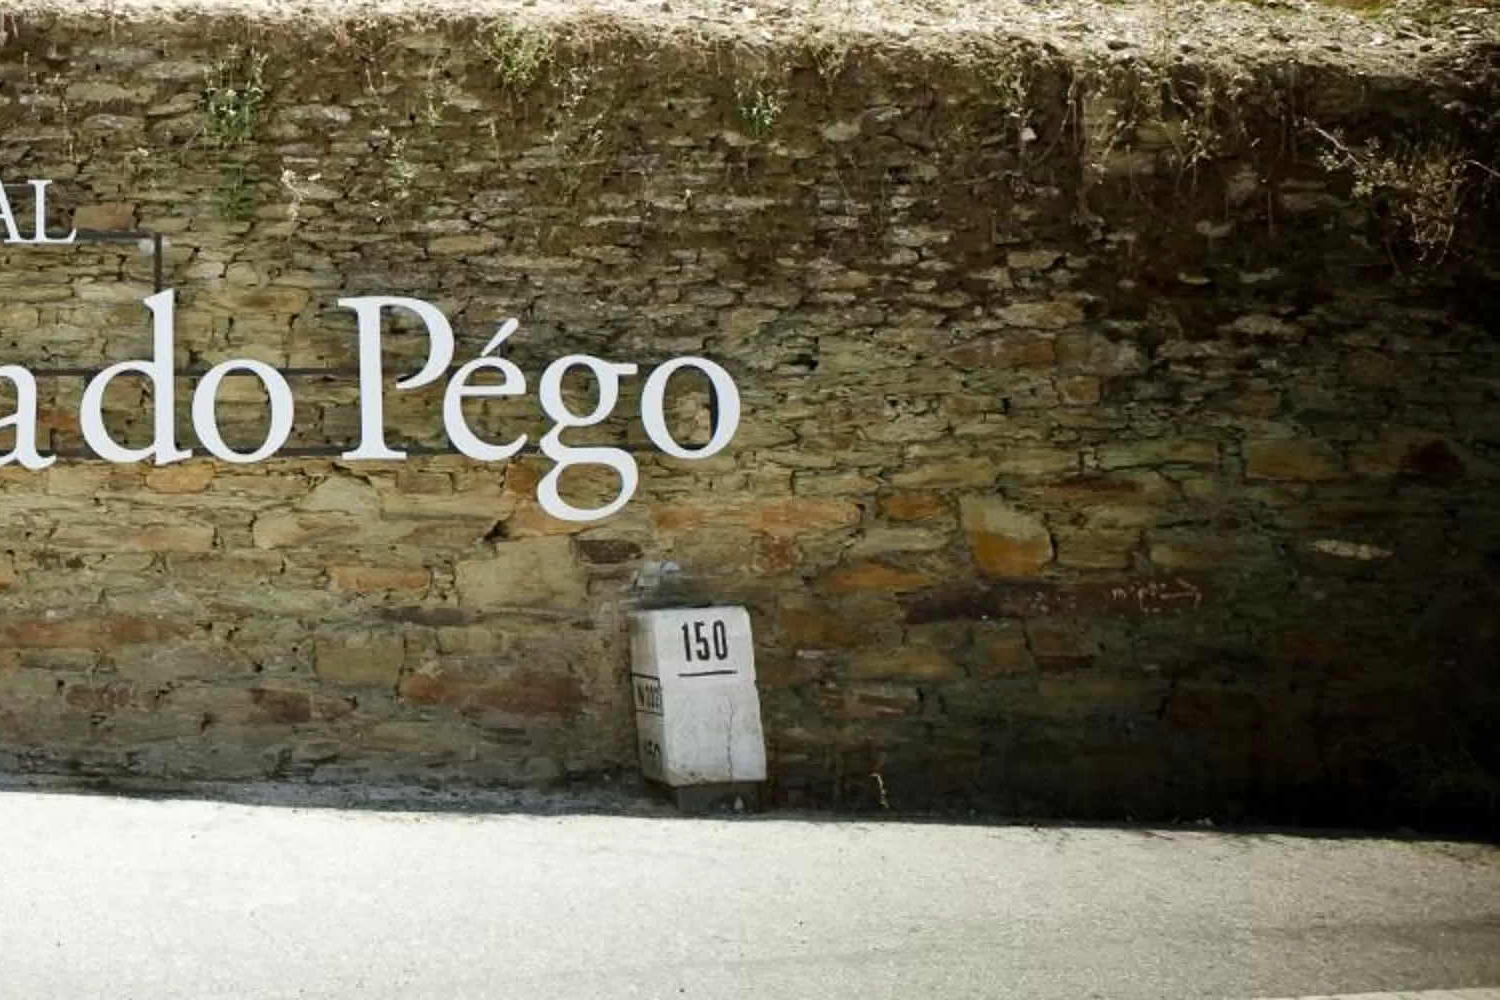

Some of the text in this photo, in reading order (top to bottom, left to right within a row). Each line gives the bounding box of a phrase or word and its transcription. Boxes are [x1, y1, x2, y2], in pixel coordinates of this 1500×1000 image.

[78, 287, 295, 467] do
[337, 295, 742, 522] Pégo
[681, 619, 729, 662] 150
